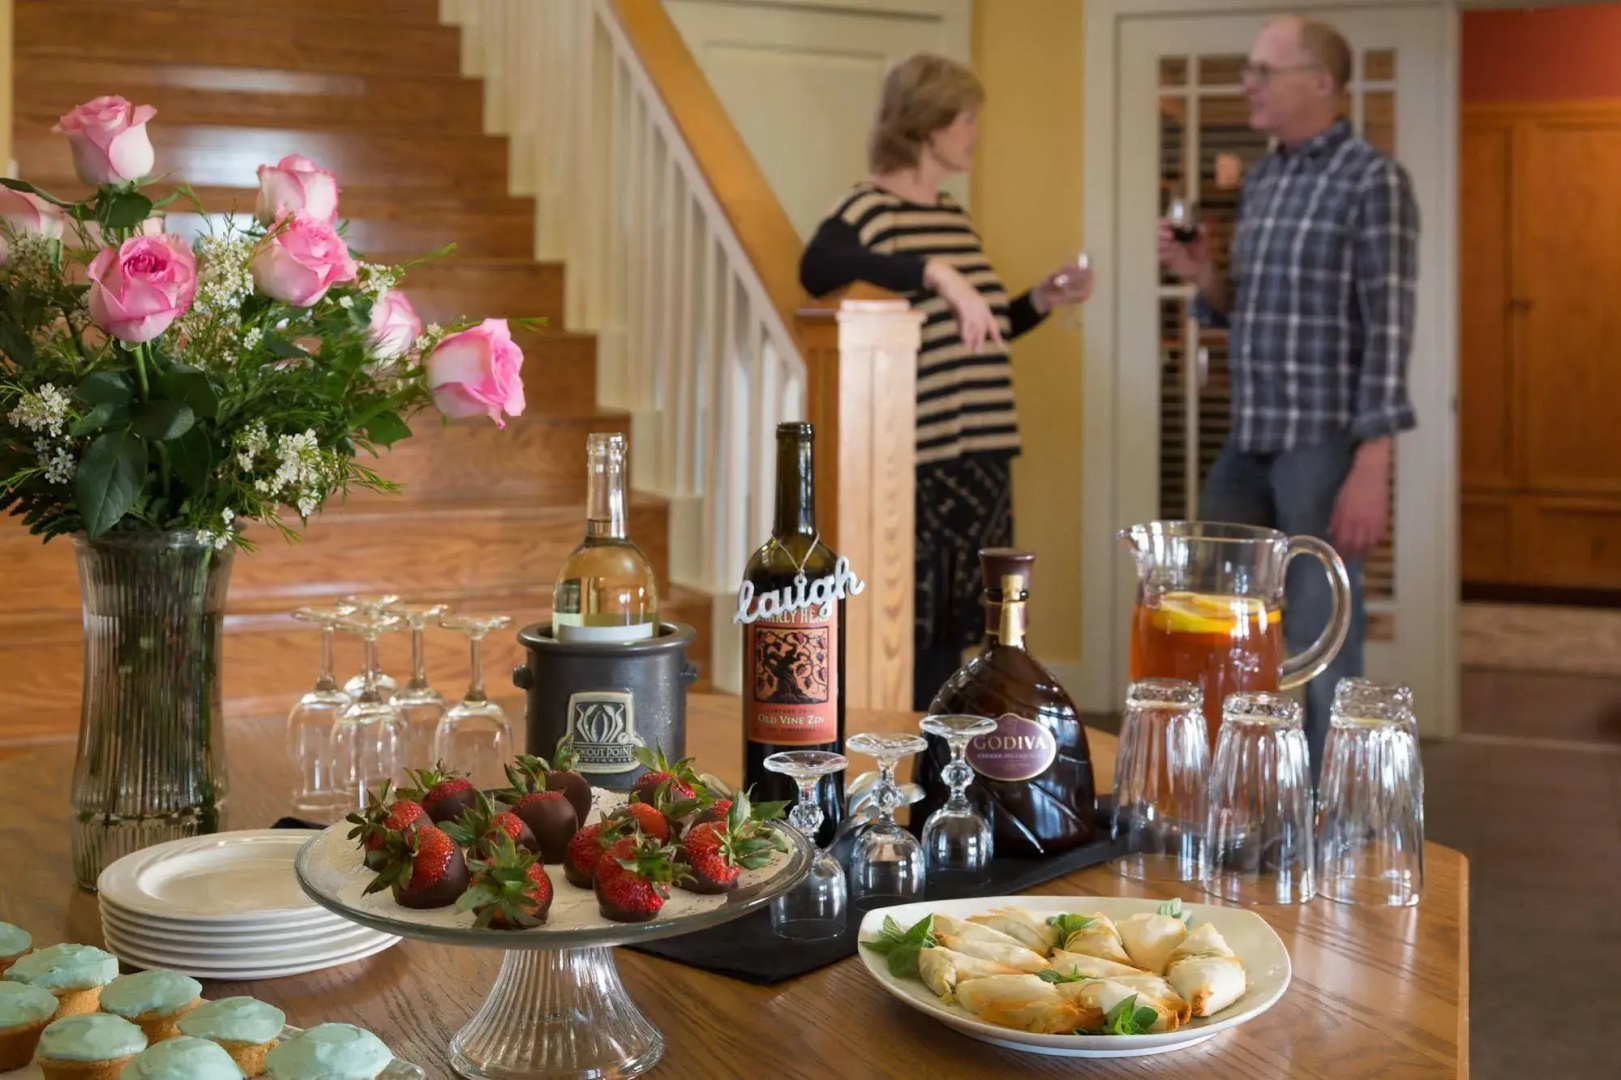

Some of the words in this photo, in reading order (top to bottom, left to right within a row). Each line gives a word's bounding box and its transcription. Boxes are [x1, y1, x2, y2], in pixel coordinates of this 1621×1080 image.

[733, 556, 865, 624] laugh
[801, 607, 829, 623] HE
[758, 714, 777, 724] OLD
[780, 715, 804, 725] VINE
[807, 715, 825, 725] ZIN
[973, 736, 1047, 750] GODIVA
